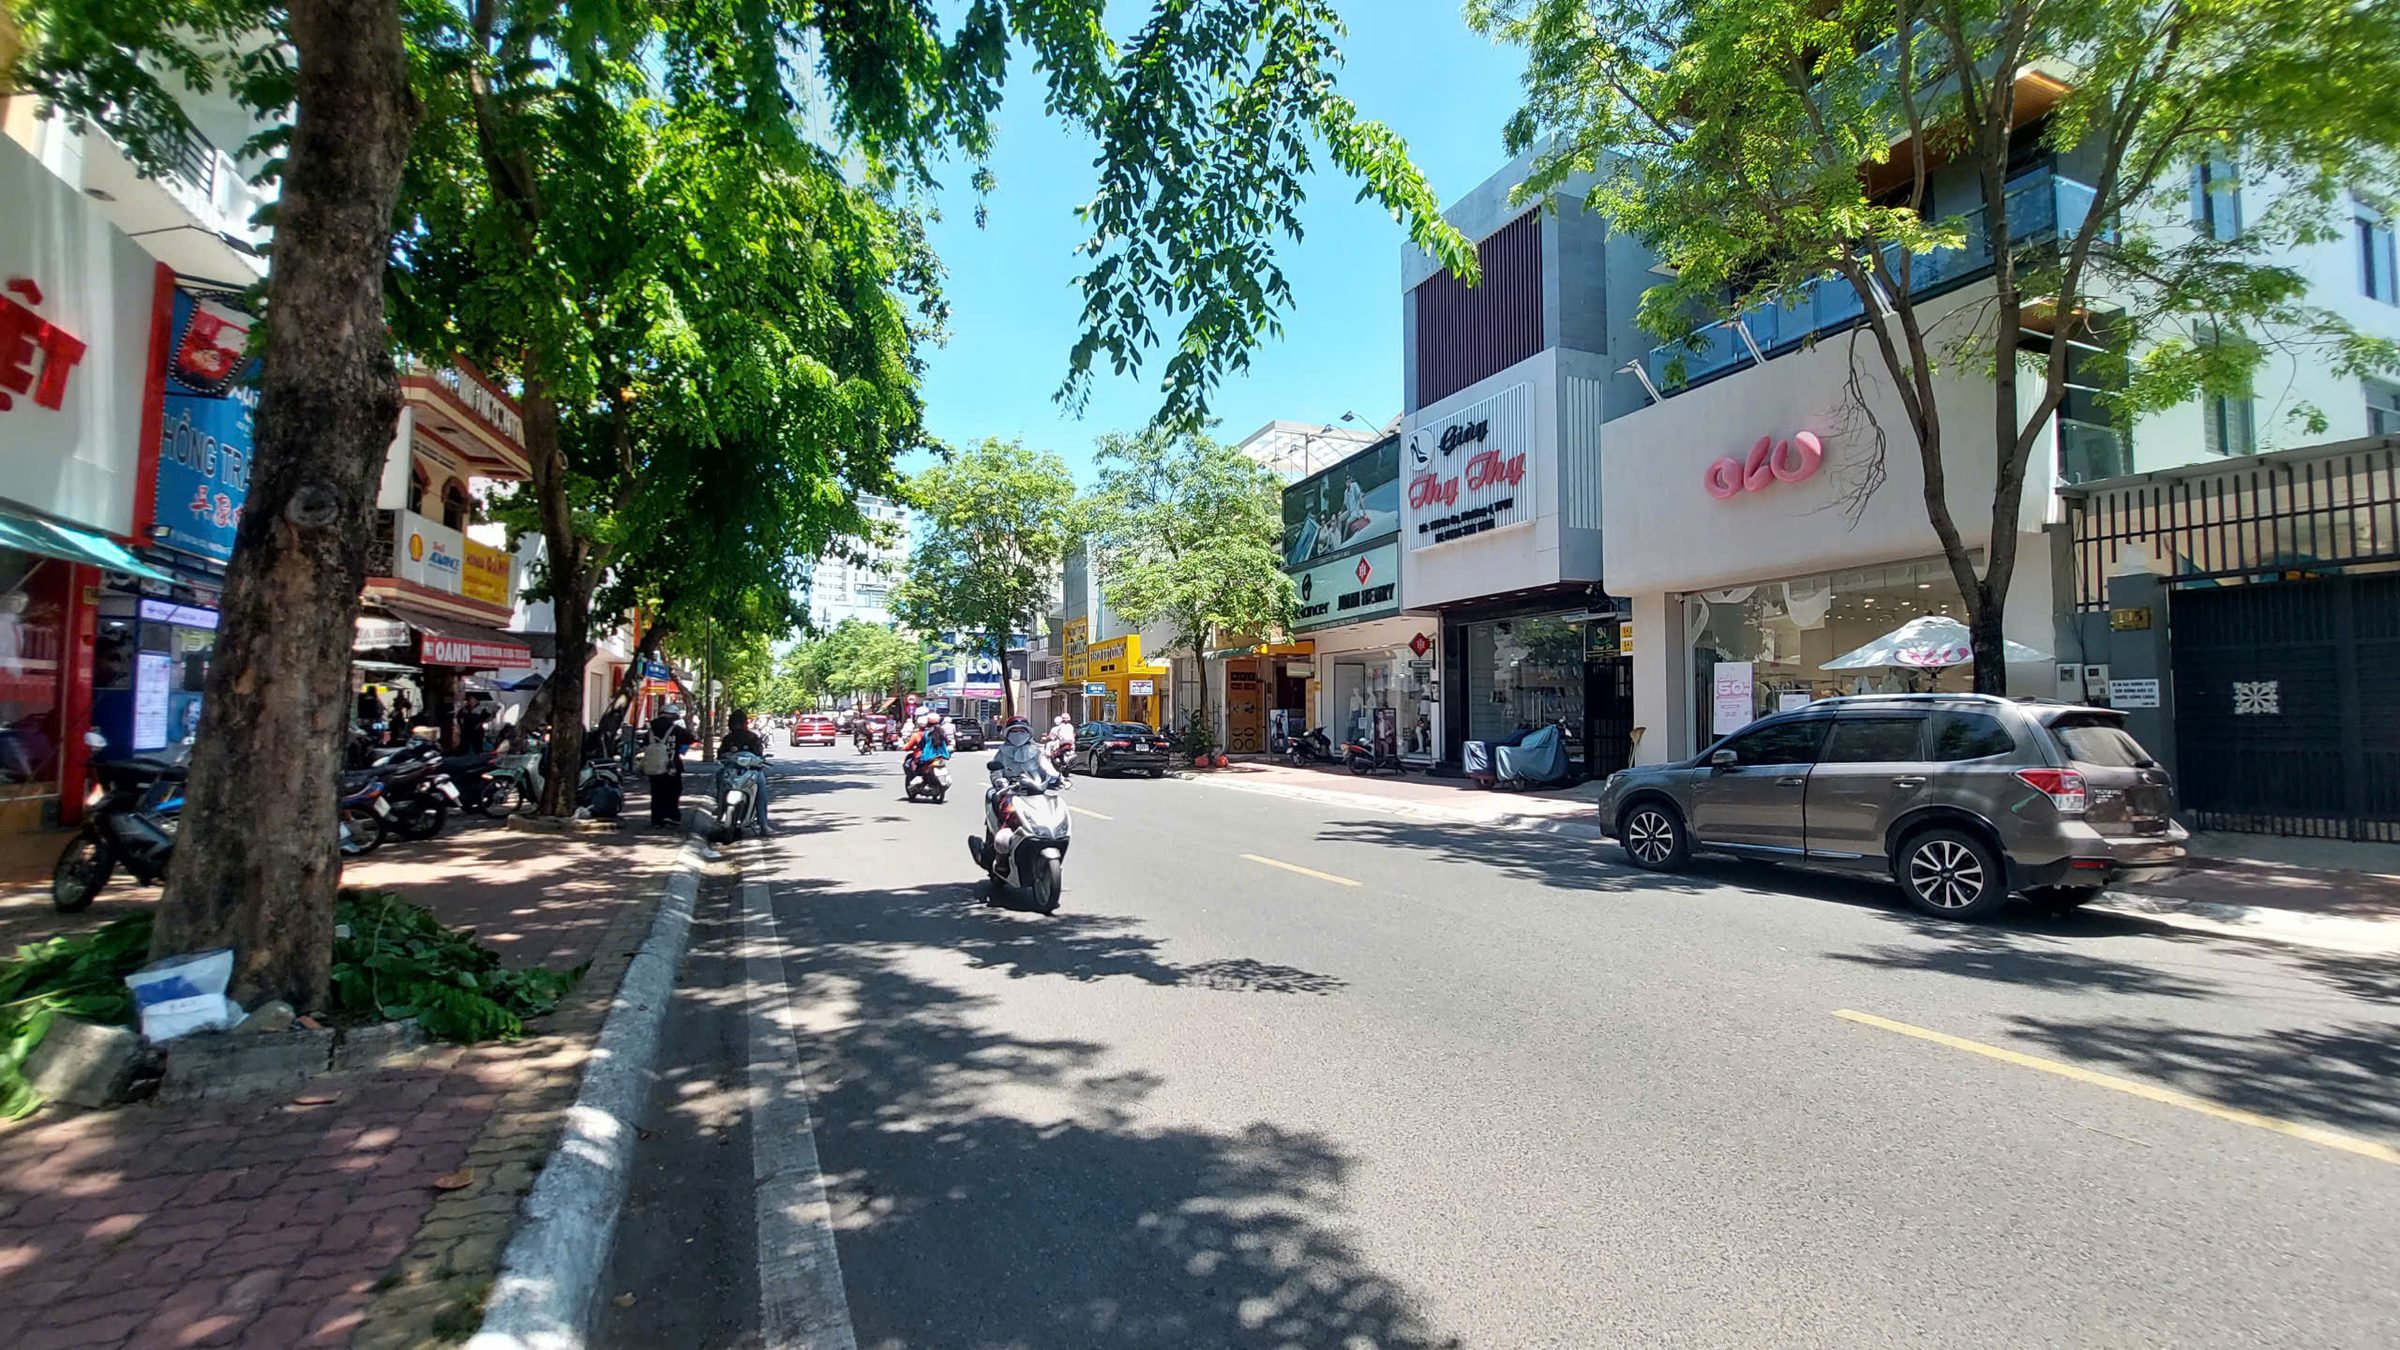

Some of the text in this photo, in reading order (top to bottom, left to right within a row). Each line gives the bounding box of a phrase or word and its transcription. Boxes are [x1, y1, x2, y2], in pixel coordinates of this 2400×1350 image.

[1408, 449, 1526, 510] Thy Thy
[435, 641, 471, 663] OANH
